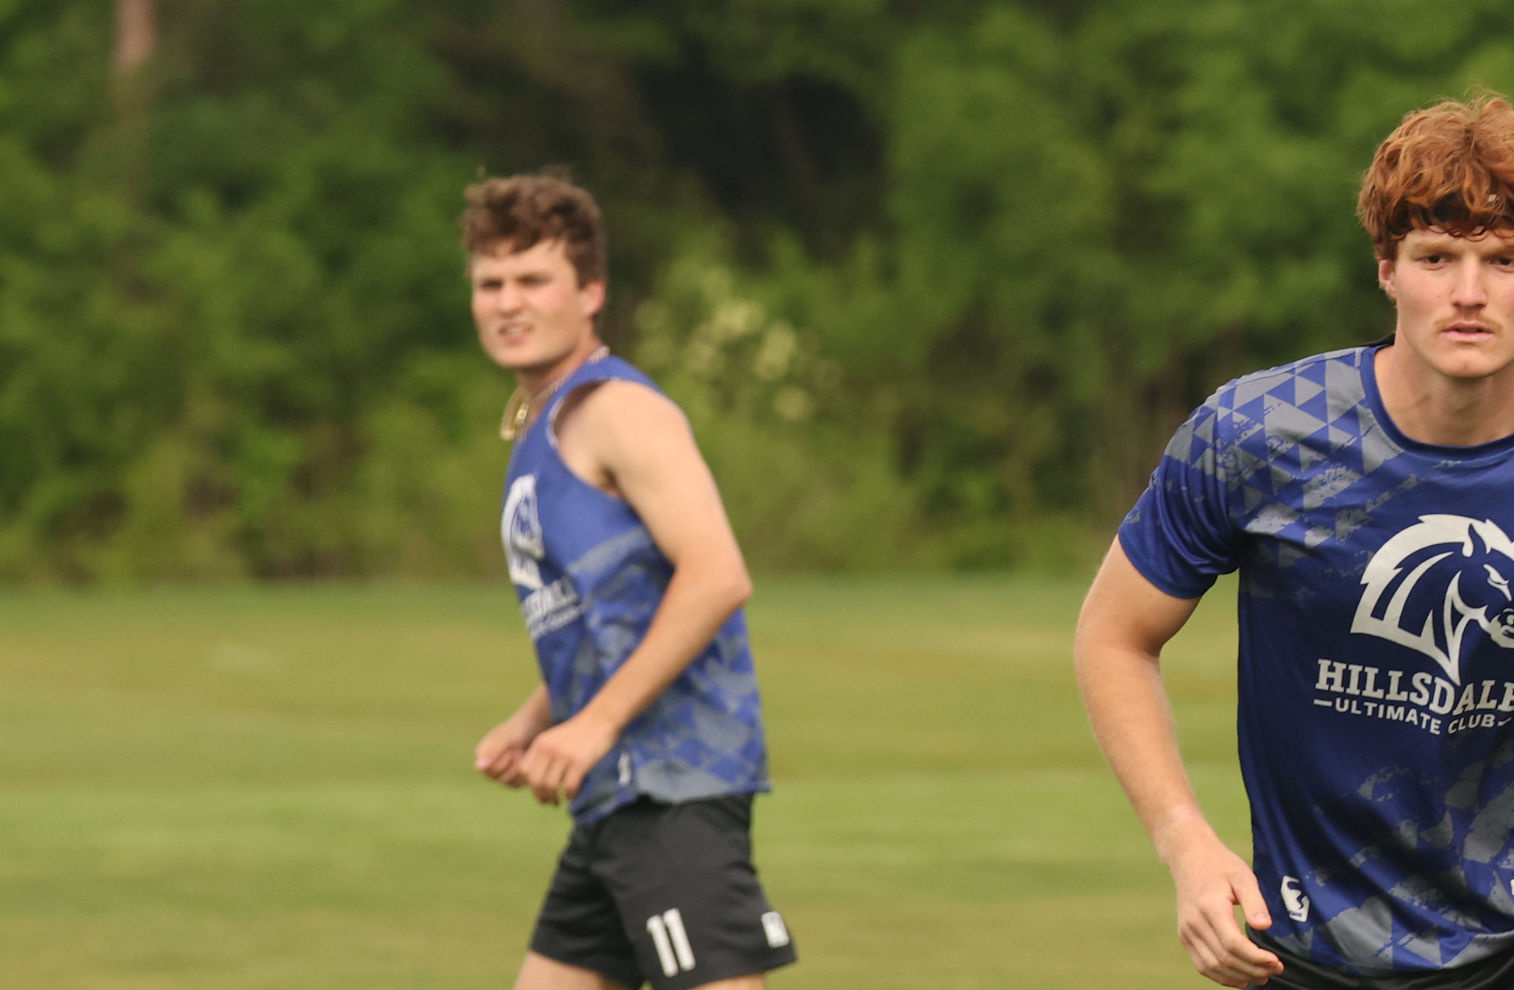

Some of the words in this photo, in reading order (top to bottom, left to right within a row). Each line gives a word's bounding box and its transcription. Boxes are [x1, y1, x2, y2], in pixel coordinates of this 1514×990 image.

[1334, 698, 1442, 735] ULTIMATE
[1448, 714, 1495, 734] CLUB
[646, 908, 696, 977] 11
